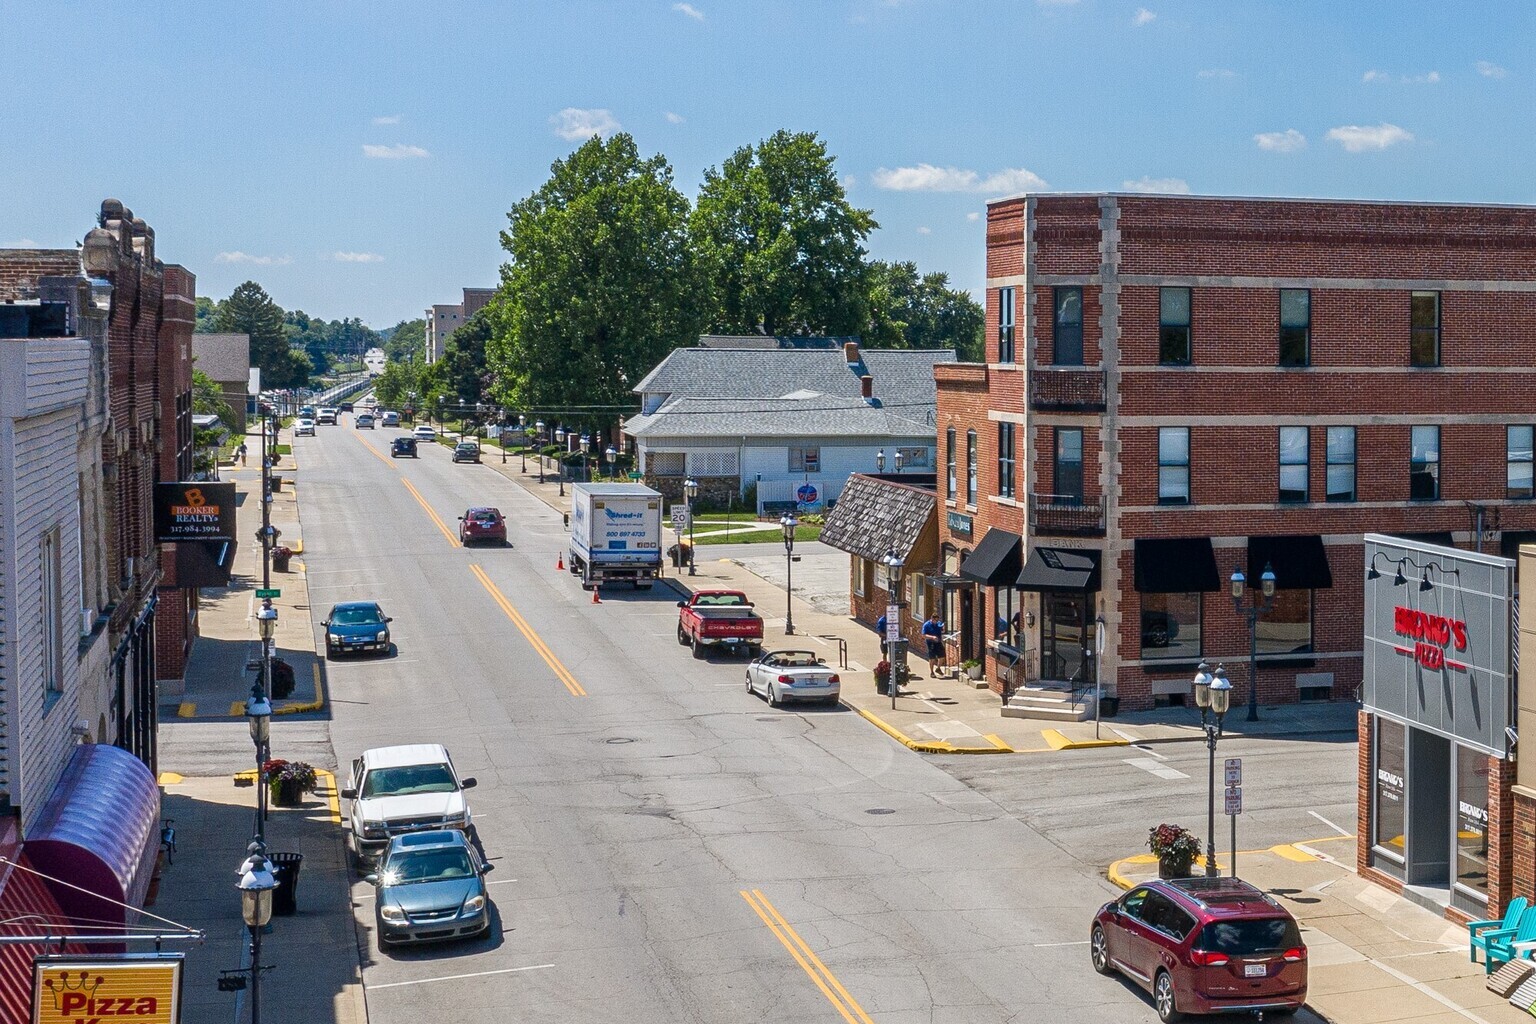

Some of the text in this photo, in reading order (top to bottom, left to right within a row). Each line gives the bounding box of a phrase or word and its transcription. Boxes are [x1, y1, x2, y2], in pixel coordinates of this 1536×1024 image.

[184, 488, 206, 507] B
[176, 506, 214, 514] BOOKER
[610, 511, 643, 519] Shred-it
[672, 514, 685, 522] 20
[170, 524, 220, 533] 317.984.3994
[1414, 641, 1444, 670] PIZZA
[61, 992, 157, 1017] Pizza
